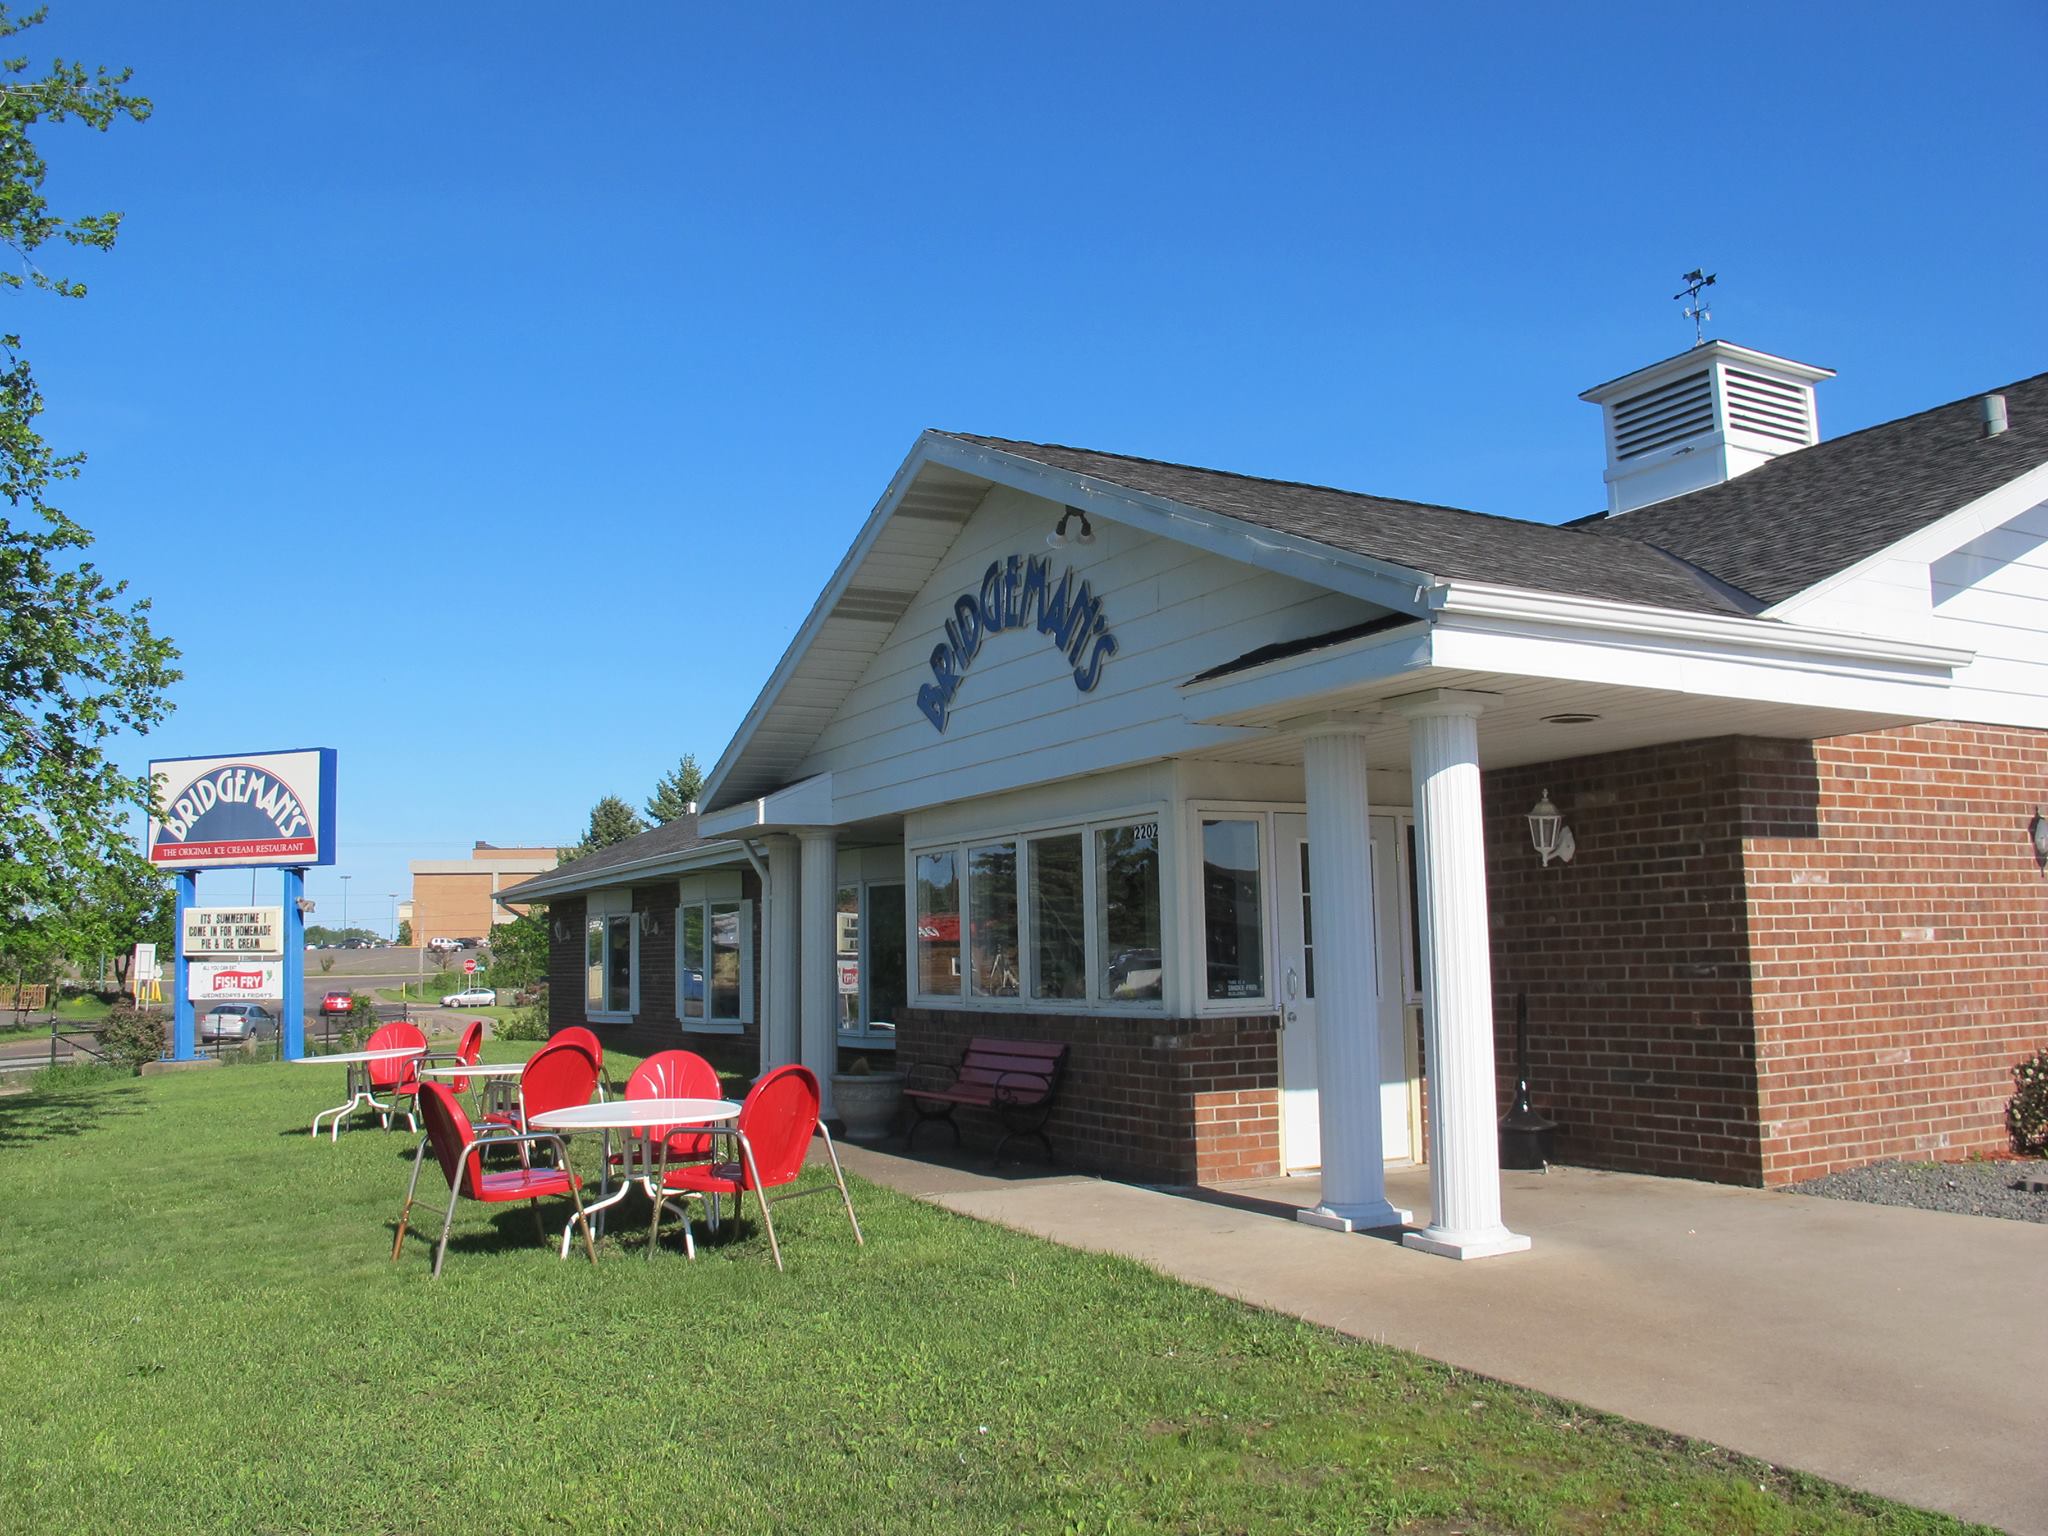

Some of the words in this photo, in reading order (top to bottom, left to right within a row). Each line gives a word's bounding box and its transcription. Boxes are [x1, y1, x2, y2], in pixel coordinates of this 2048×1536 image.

[916, 554, 1119, 735] BRIDGEMAN'S
[163, 769, 307, 842] BRIDGEMAN'S
[1134, 823, 1158, 840] 2202
[163, 848, 177, 857] THE
[178, 847, 212, 856] ORIGINAL
[214, 846, 225, 855] ICE
[226, 845, 254, 855] CREAM
[255, 843, 304, 853] RESTAURANT
[200, 914, 211, 924] ITS
[216, 913, 260, 924] SUMMERTIME
[189, 926, 206, 936] COME
[210, 926, 218, 936] IN
[220, 926, 232, 936] FOR
[235, 925, 272, 936] HOMEMADE
[201, 938, 211, 949] PIE
[214, 939, 220, 949] &
[223, 938, 234, 949] ICE
[238, 938, 261, 949] CREAM
[215, 976, 238, 988] FISH
[240, 975, 261, 988] FRY
